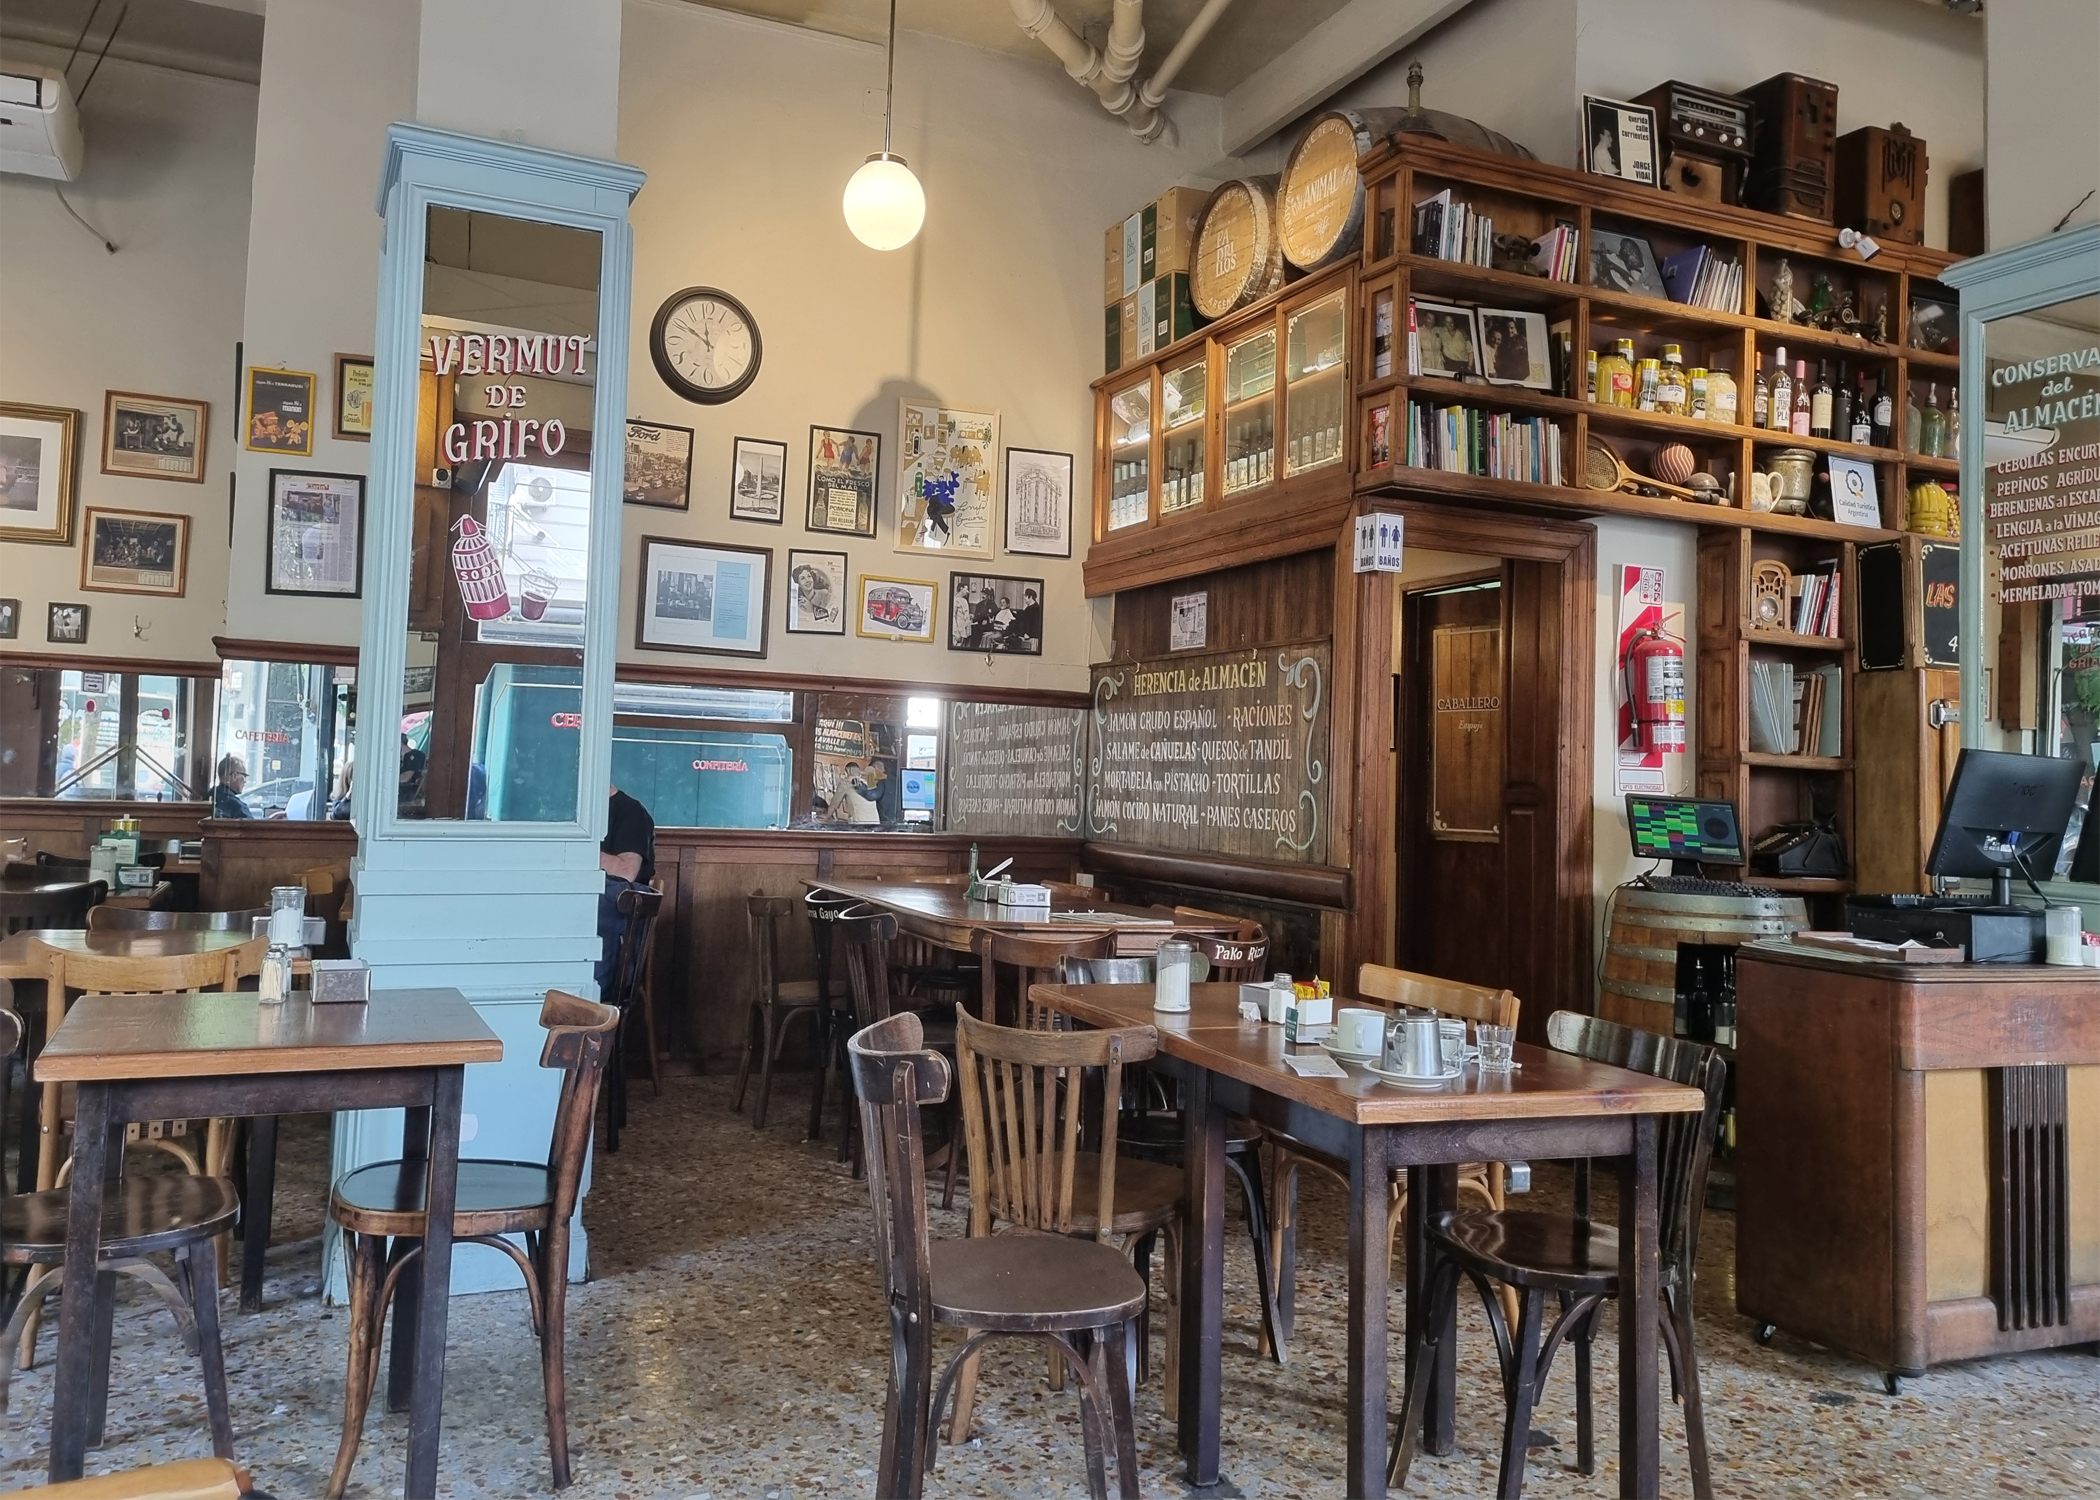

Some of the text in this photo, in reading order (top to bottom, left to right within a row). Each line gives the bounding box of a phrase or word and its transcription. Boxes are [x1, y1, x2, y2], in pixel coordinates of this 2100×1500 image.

[1628, 115, 1648, 126] querida
[1635, 125, 1649, 133] calle
[1621, 130, 1649, 141] corrientes
[1632, 160, 1651, 171] JORGE
[1635, 170, 1651, 181] VIDAL
[1303, 167, 1338, 209] ANIMAL
[1216, 227, 1230, 248] PA
[1216, 241, 1236, 263] DRI
[1215, 254, 1237, 278] LLOS
[1208, 275, 1247, 311] ARGENTINA
[429, 333, 591, 376] VERMUT
[1992, 346, 2100, 388] CONSERVA
[484, 384, 527, 409] DE
[2041, 375, 2074, 397] del
[442, 411, 567, 467] GRIFO
[627, 425, 662, 442] Ford
[1996, 451, 2054, 475] CEBOLLAS
[816, 475, 837, 483] COMO
[845, 479, 870, 488] FRESCO
[1996, 475, 2049, 498] PEPINOS
[1838, 499, 1876, 511] Calidad Turística
[1847, 508, 1869, 518] Argentina
[1989, 495, 2056, 519] BERENJENAS
[2056, 495, 2067, 508] al
[1996, 518, 2044, 539] LENGUA
[2045, 522, 2052, 532] a
[2053, 519, 2063, 532] la
[1997, 538, 2064, 560] ACEITUNAS
[1360, 554, 1374, 567] BAÑOS
[1378, 554, 1400, 568] BAÑOS
[1998, 560, 2065, 583] MORRONES
[1925, 582, 1955, 609] LAS
[1997, 583, 2067, 605] MERMELADA
[1948, 635, 1959, 653] 4
[1134, 670, 1186, 696] HERENCIA
[1188, 668, 1200, 691] de
[1437, 697, 1500, 711] CABALLERO
[1107, 707, 1137, 733] JAMÓN
[1139, 710, 1171, 734] CRUDO
[1173, 704, 1218, 731] ESPAÑOL
[1458, 720, 1484, 733] Empuje
[1106, 740, 1140, 761] SALAME
[1140, 745, 1150, 760] de
[1239, 745, 1248, 760] de
[1249, 733, 1292, 761] TANDIL
[692, 758, 749, 772] CONFITERÍA
[1104, 770, 1152, 793] MORTADELA
[1153, 781, 1163, 792] con
[1164, 768, 1209, 793] PISTACHO
[1093, 795, 1120, 819] JAMÓN
[1122, 797, 1150, 820] COCIDO
[1152, 802, 1199, 829] NATURAL
[1243, 807, 1296, 837] CASEROS
[819, 907, 839, 922] Gayo
